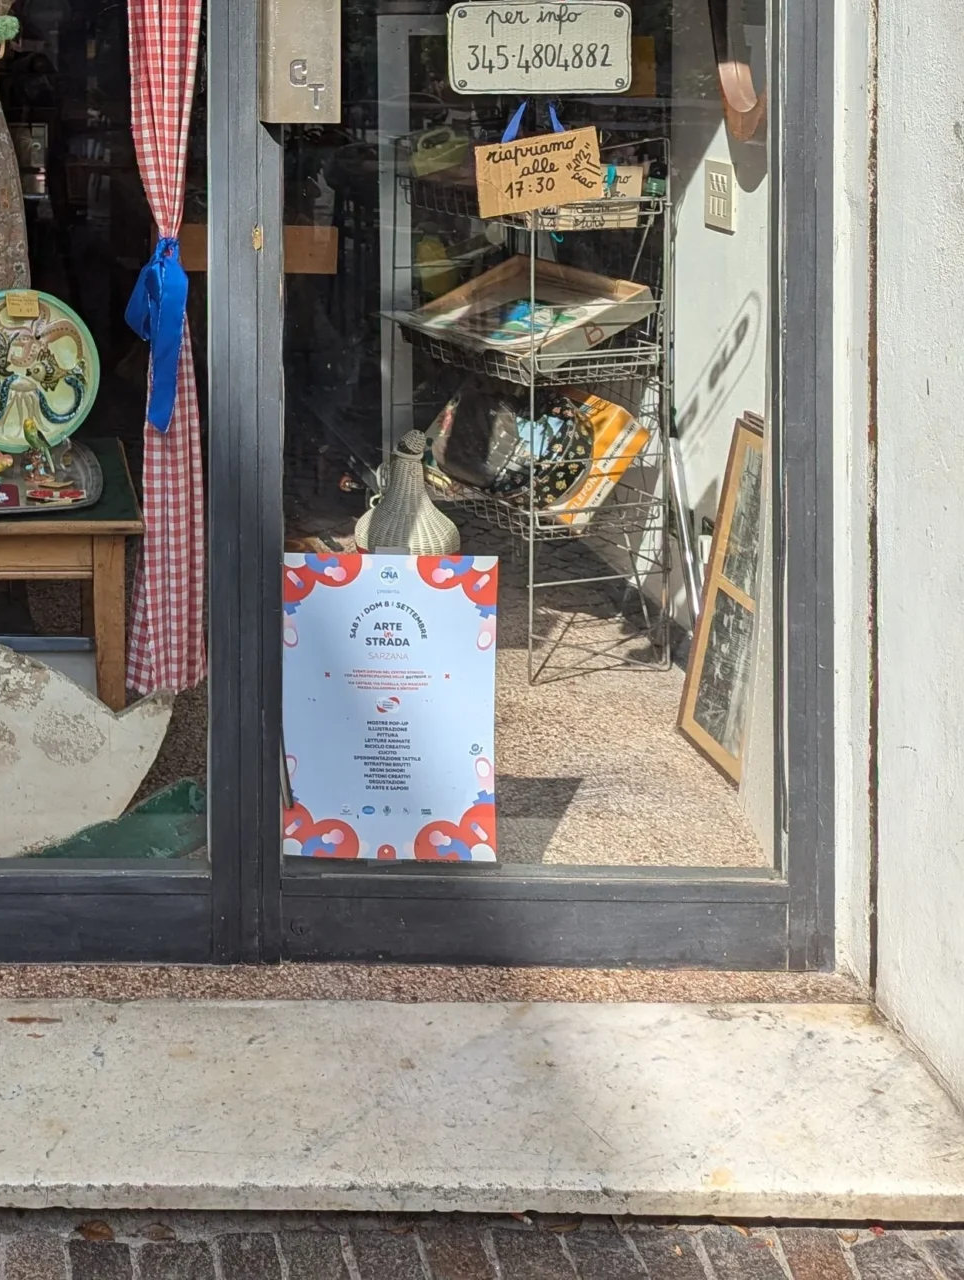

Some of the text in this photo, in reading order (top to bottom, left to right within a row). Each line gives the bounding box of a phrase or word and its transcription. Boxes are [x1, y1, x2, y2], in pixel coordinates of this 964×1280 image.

[485, 4, 582, 38] per info
[485, 136, 577, 166] riapriamo
[518, 158, 560, 179] alle
[504, 177, 556, 200] 17:30
[570, 172, 598, 189] ciao
[380, 571, 398, 579] CNA
[350, 622, 359, 639] SAB
[364, 602, 383, 615] DOM
[396, 602, 428, 640] SETTEMBRE
[374, 622, 402, 631] ARTE
[365, 638, 410, 647] STRADA
[368, 652, 409, 661] SARZANA
